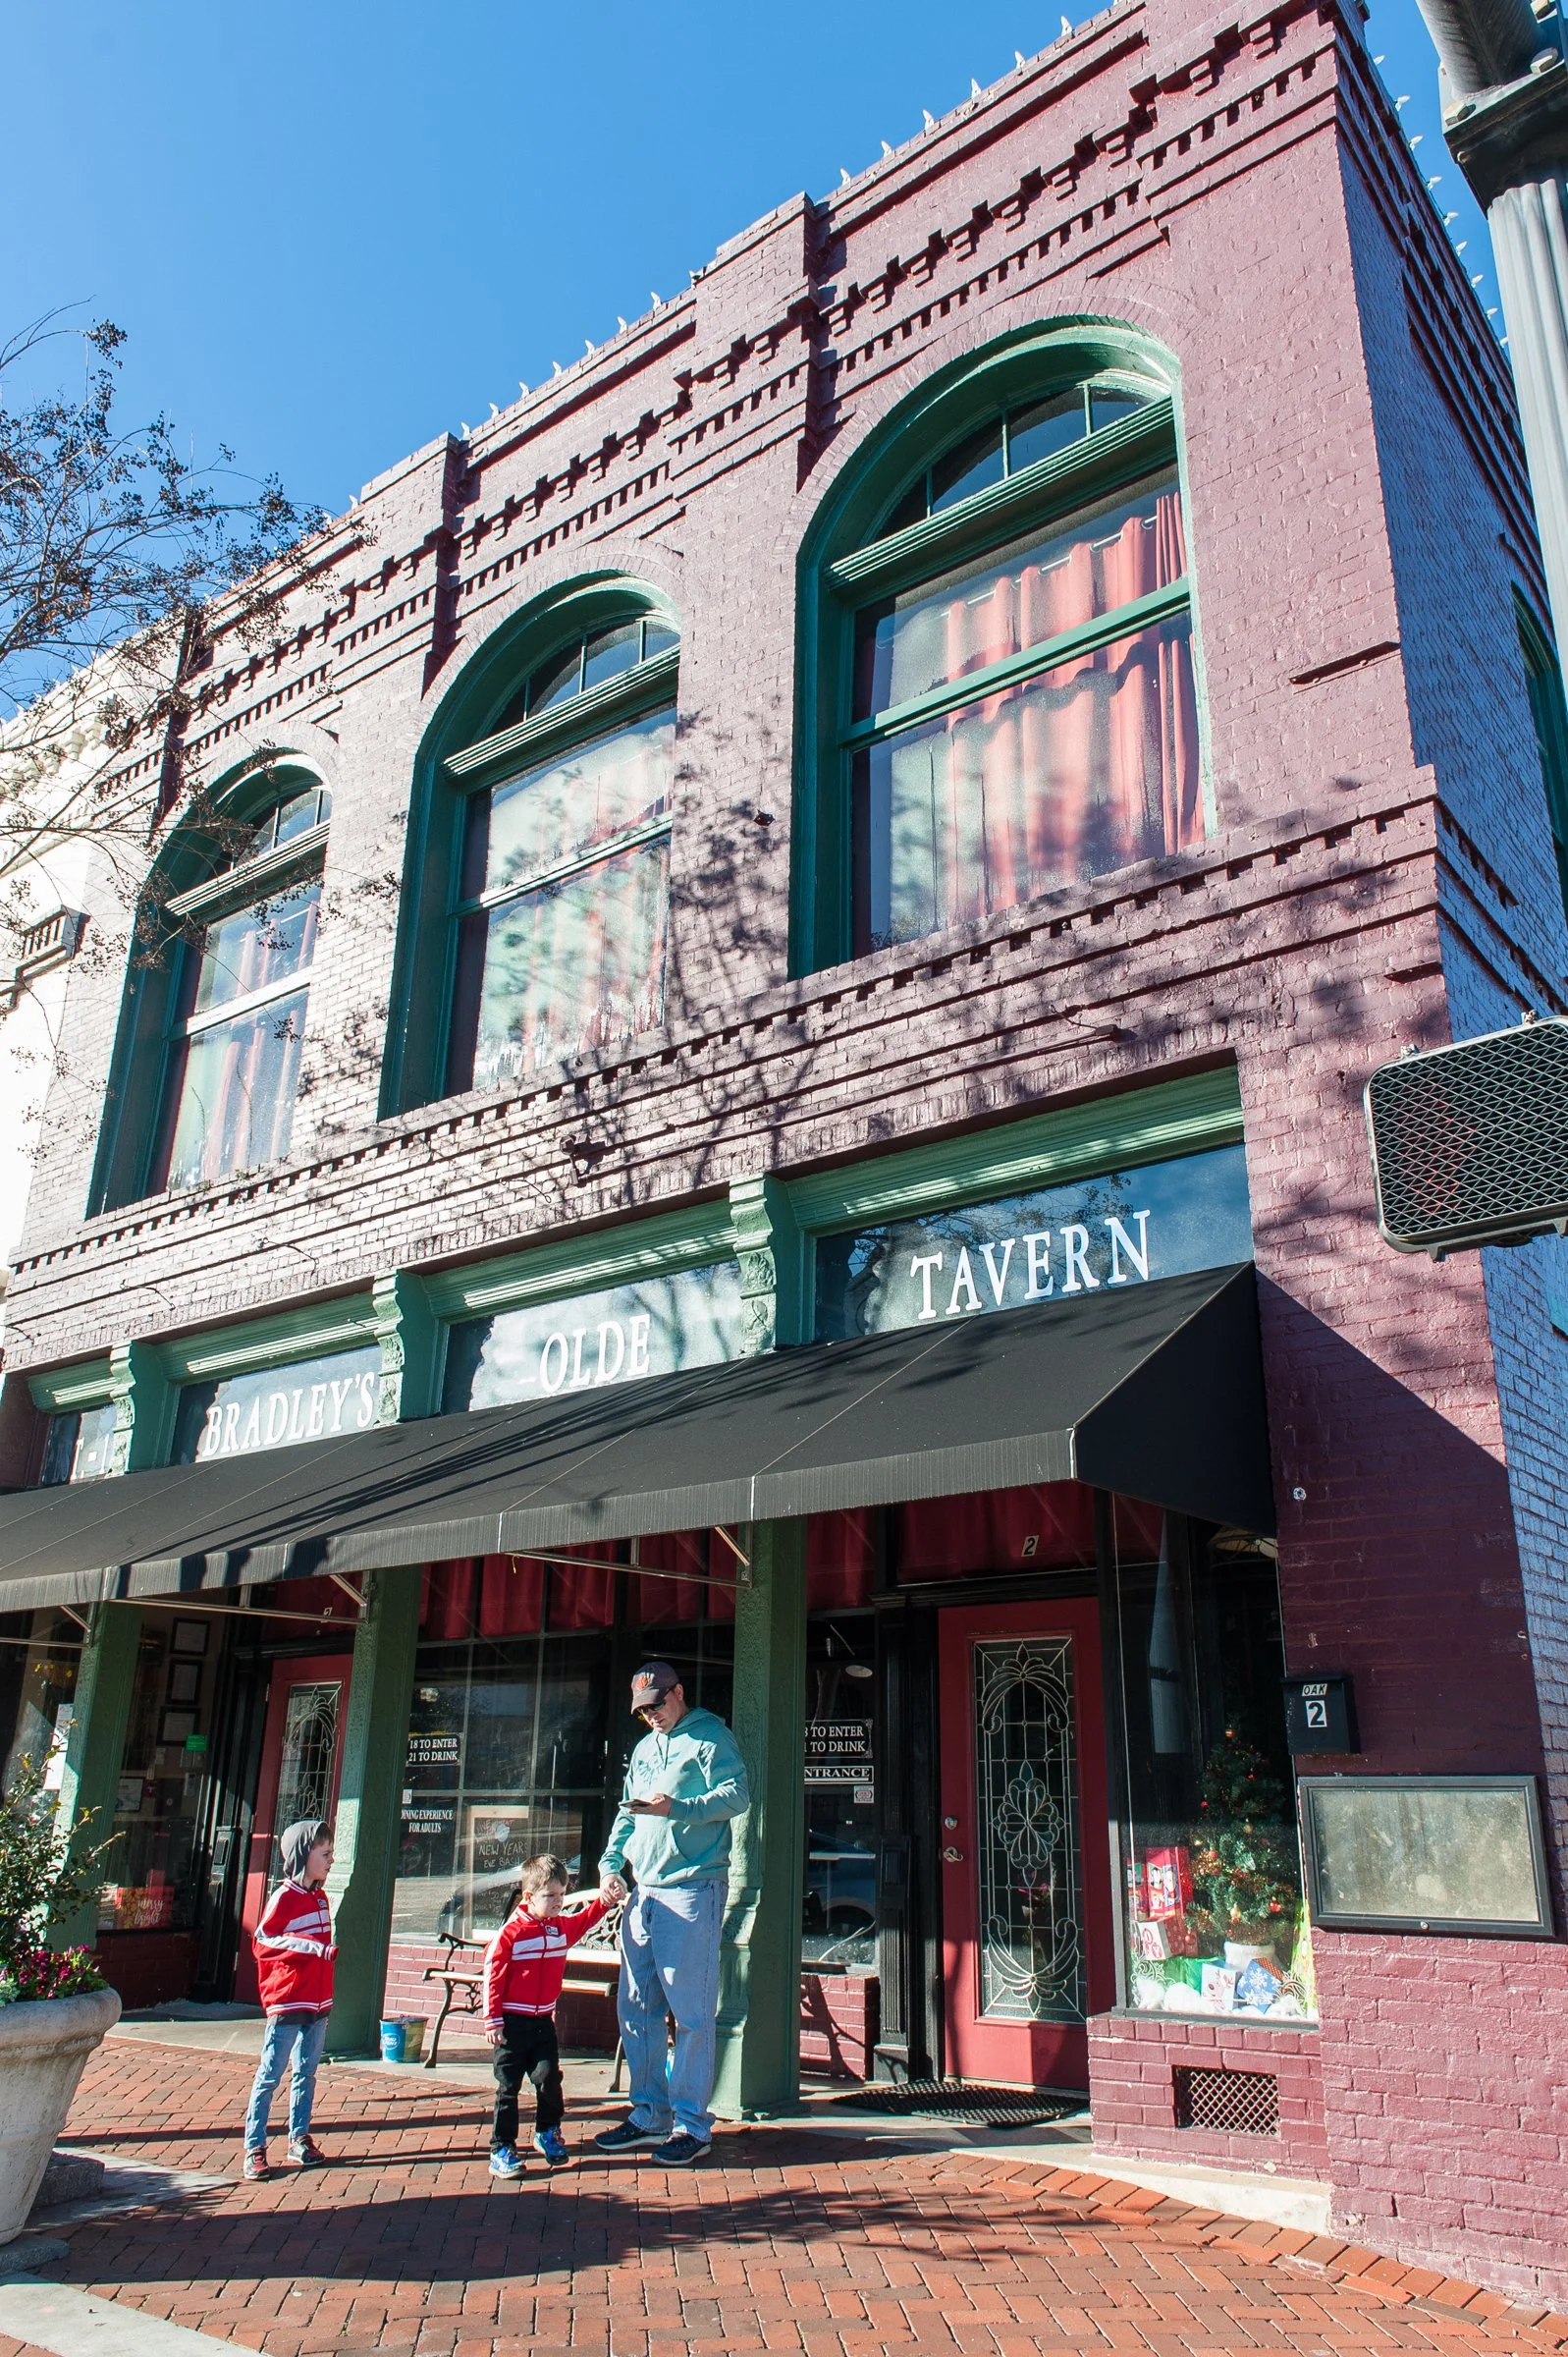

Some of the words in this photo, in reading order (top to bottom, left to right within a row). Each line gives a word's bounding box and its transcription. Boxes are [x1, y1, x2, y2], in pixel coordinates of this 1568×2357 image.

[201, 1371, 375, 1457] BRADLEY'S
[540, 1313, 651, 1393] OLDE
[909, 1209, 1151, 1320] TAVERN
[1023, 1537, 1036, 1556] 2
[1304, 1684, 1325, 1695] OAK
[1308, 1701, 1325, 1726] 2
[810, 1727, 827, 1737] TO
[829, 1726, 864, 1737] ENTER
[409, 1740, 418, 1749] 18
[419, 1739, 431, 1749] TO
[432, 1738, 458, 1748] ENTER
[810, 1741, 827, 1752] TO
[829, 1740, 866, 1752] DRINK
[408, 1752, 416, 1762] 21
[418, 1752, 430, 1762] TO
[431, 1751, 459, 1761] DRINK
[804, 1768, 870, 1778] NTRANCE
[419, 1809, 454, 1820] EXPERIENCE
[408, 1822, 420, 1833] FOR
[420, 1822, 442, 1833] ADULTS
[478, 1842, 499, 1856] NEW
[483, 1859, 496, 1869] EVE
